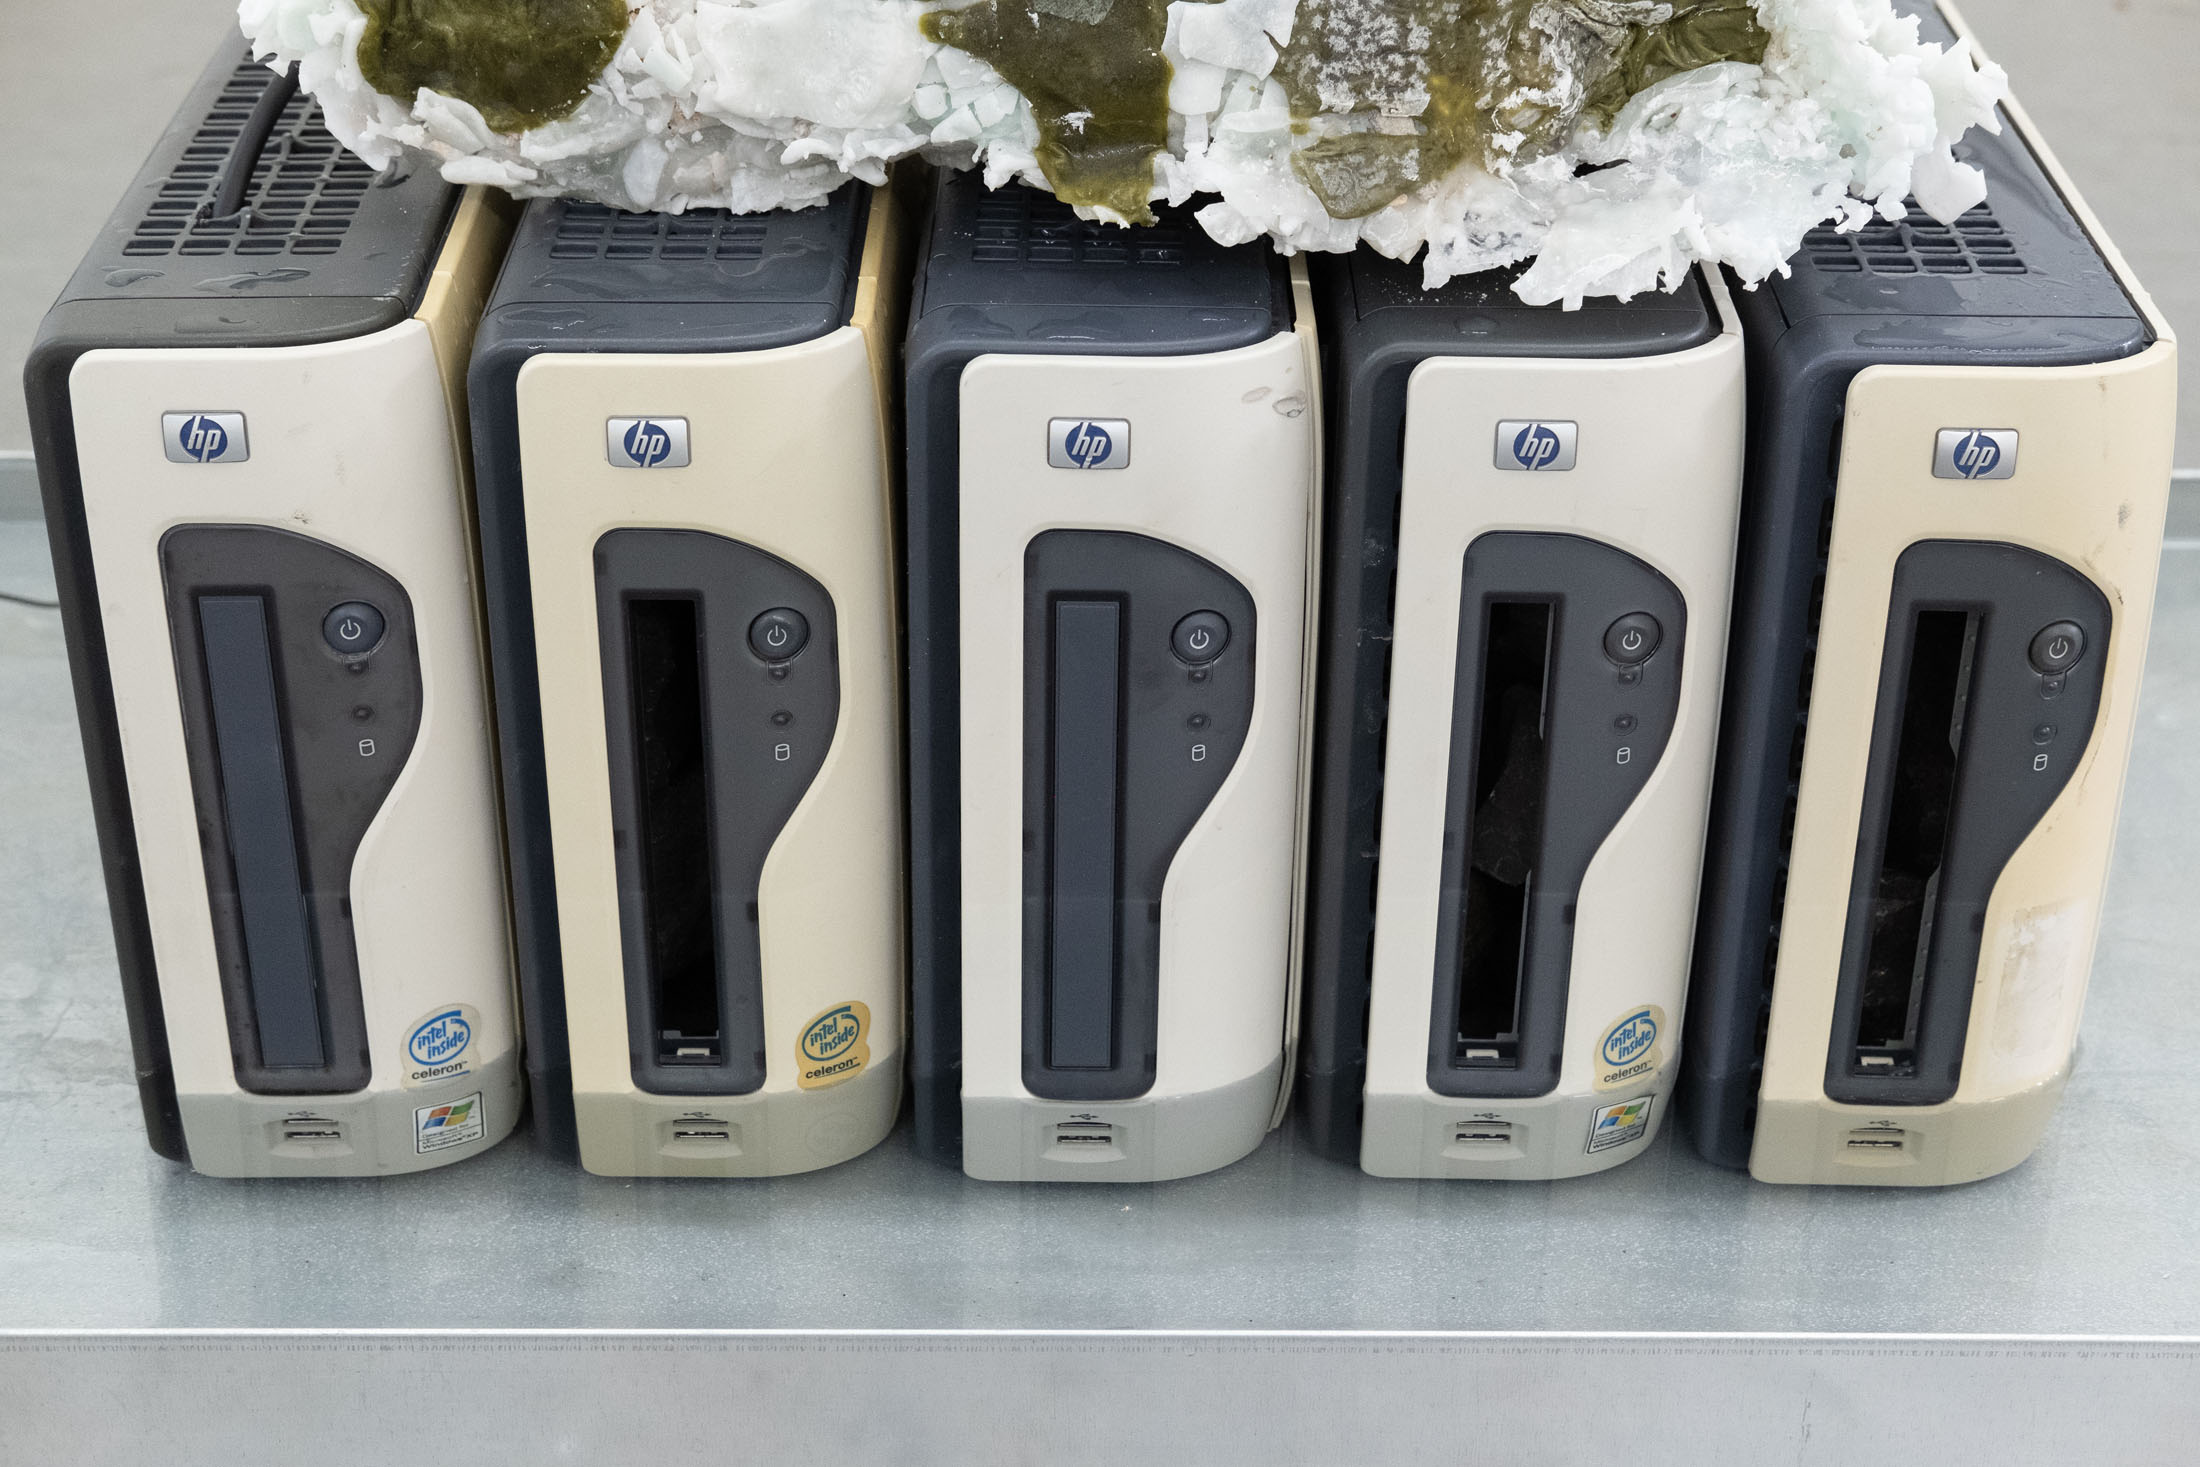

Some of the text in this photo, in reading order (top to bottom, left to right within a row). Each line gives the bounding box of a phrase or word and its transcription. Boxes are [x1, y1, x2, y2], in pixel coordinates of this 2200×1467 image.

[187, 415, 221, 462] hp
[630, 420, 665, 467] hp
[1071, 421, 1107, 468] hp
[1519, 423, 1555, 470] hp
[1958, 430, 1996, 479] hp
[417, 1020, 446, 1050] intel
[428, 1031, 465, 1059] inside
[810, 1017, 837, 1047] intel
[820, 1025, 855, 1055] inside
[1610, 1021, 1637, 1052] intel
[1618, 1030, 1652, 1060] inside
